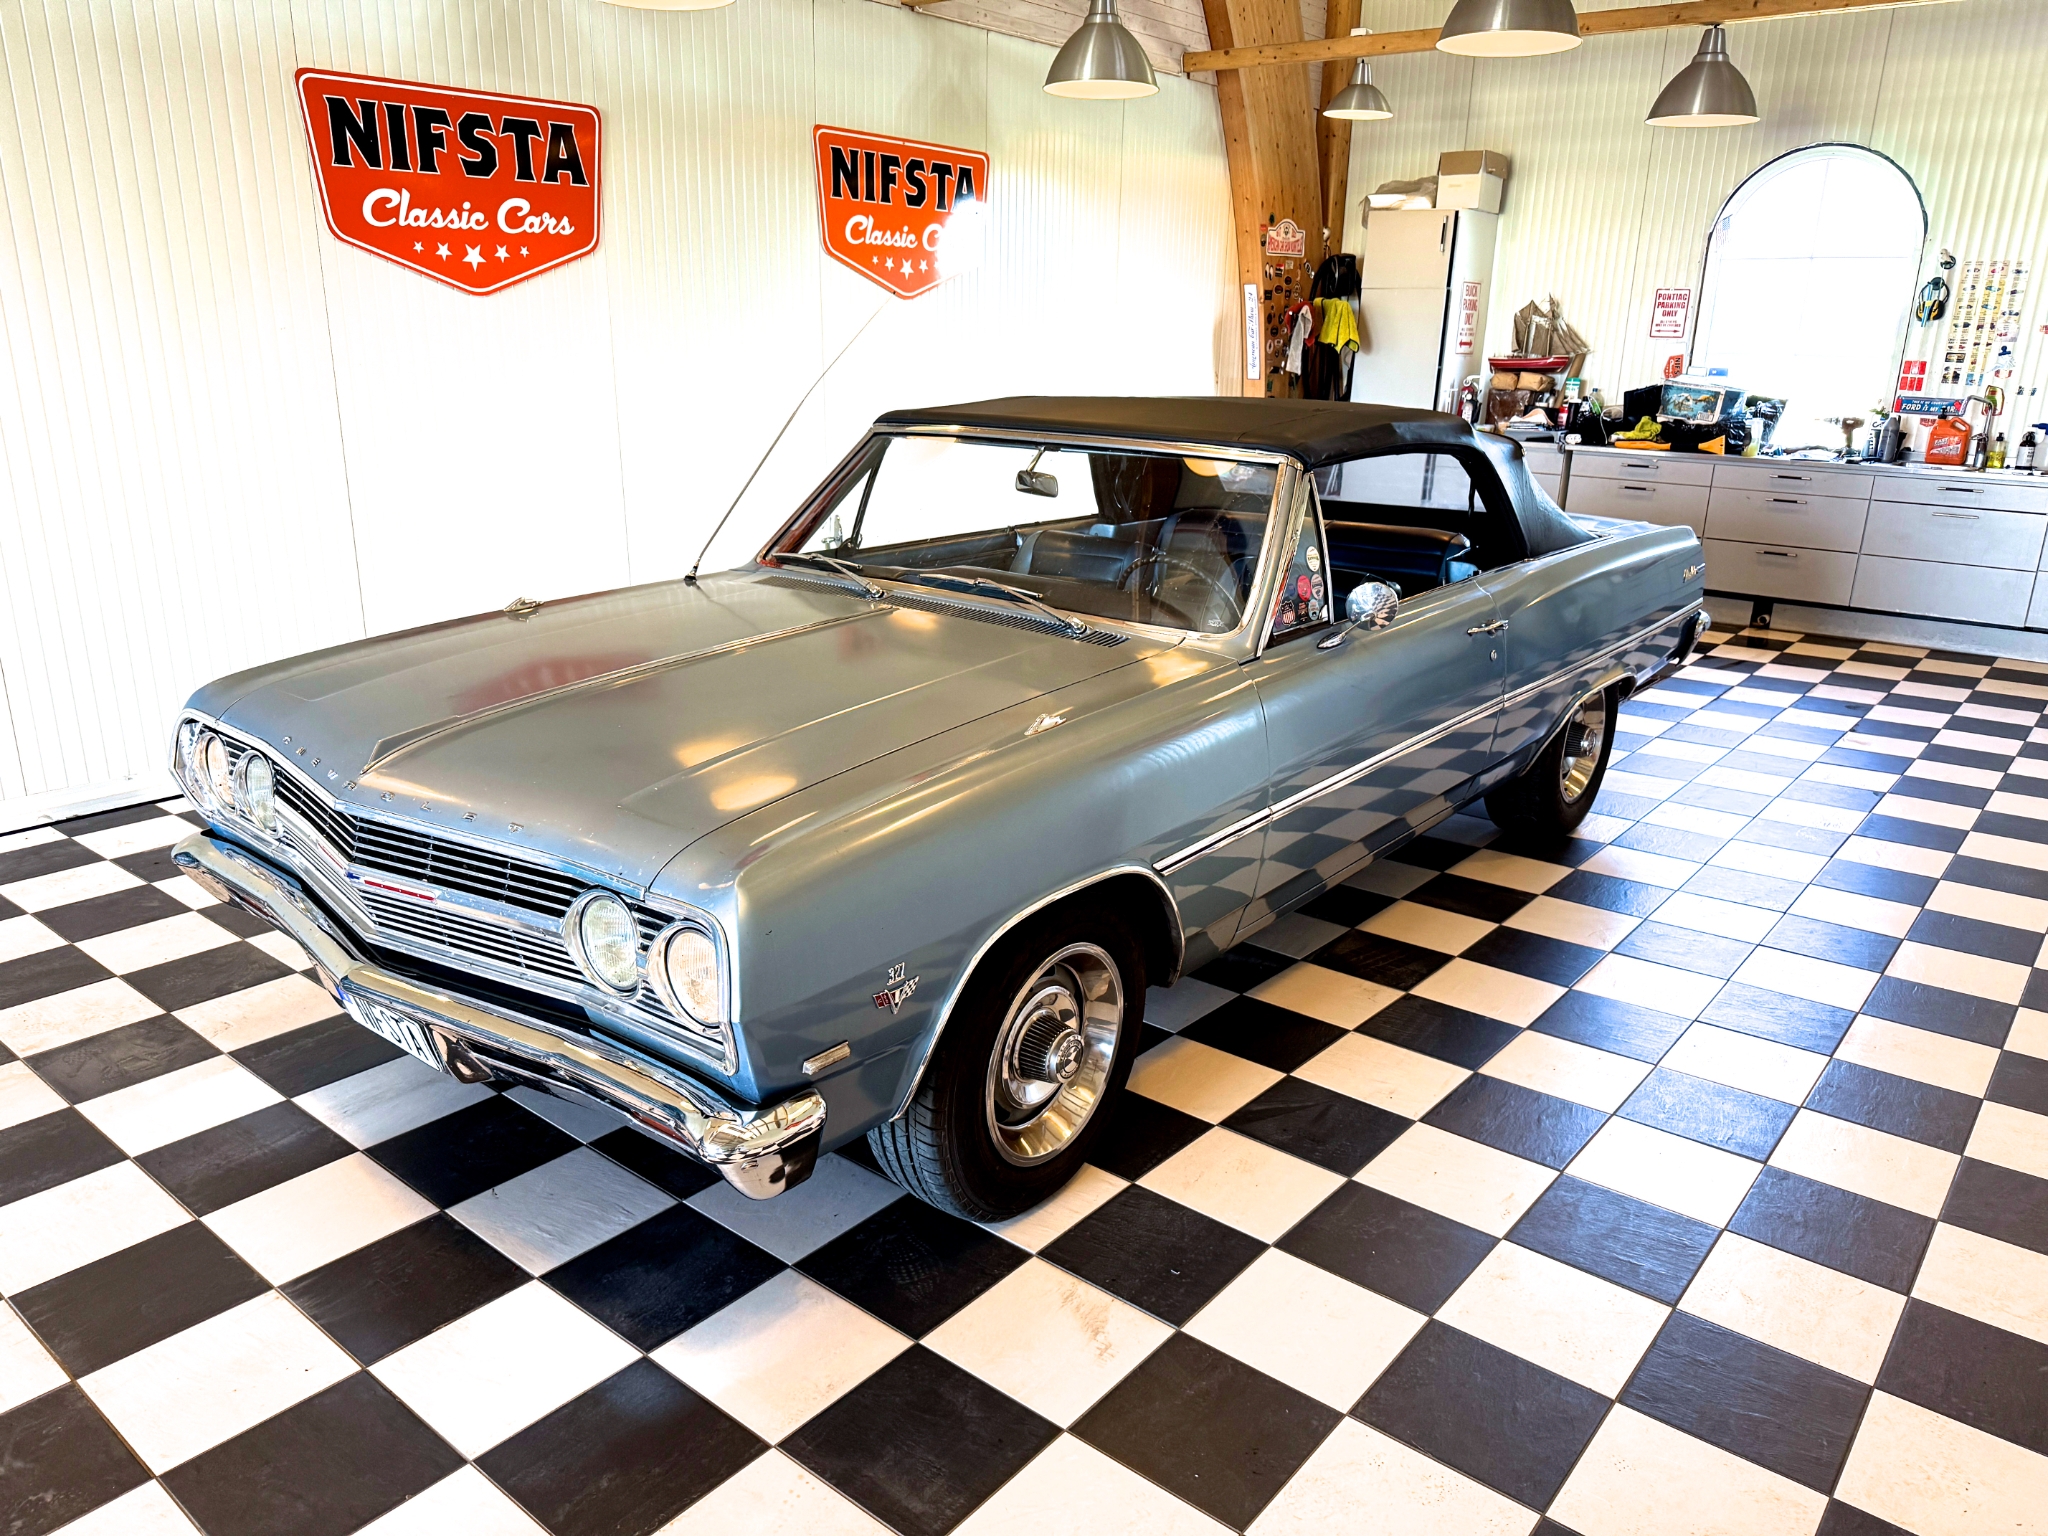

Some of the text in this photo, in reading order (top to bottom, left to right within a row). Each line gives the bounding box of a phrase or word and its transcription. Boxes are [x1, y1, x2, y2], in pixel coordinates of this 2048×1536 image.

[323, 94, 590, 187] NIFSTA
[829, 145, 976, 212] NIFSTA
[362, 187, 575, 235] Classic Cars
[844, 214, 918, 248] Classic
[1465, 284, 1478, 297] BUICK
[1657, 293, 1688, 301] PONTIAC
[1463, 298, 1478, 311] PARKING
[1656, 301, 1686, 309] PARKING
[1901, 403, 1921, 411] FORD
[887, 962, 905, 985] 327
[352, 995, 429, 1061] NIFSTA
